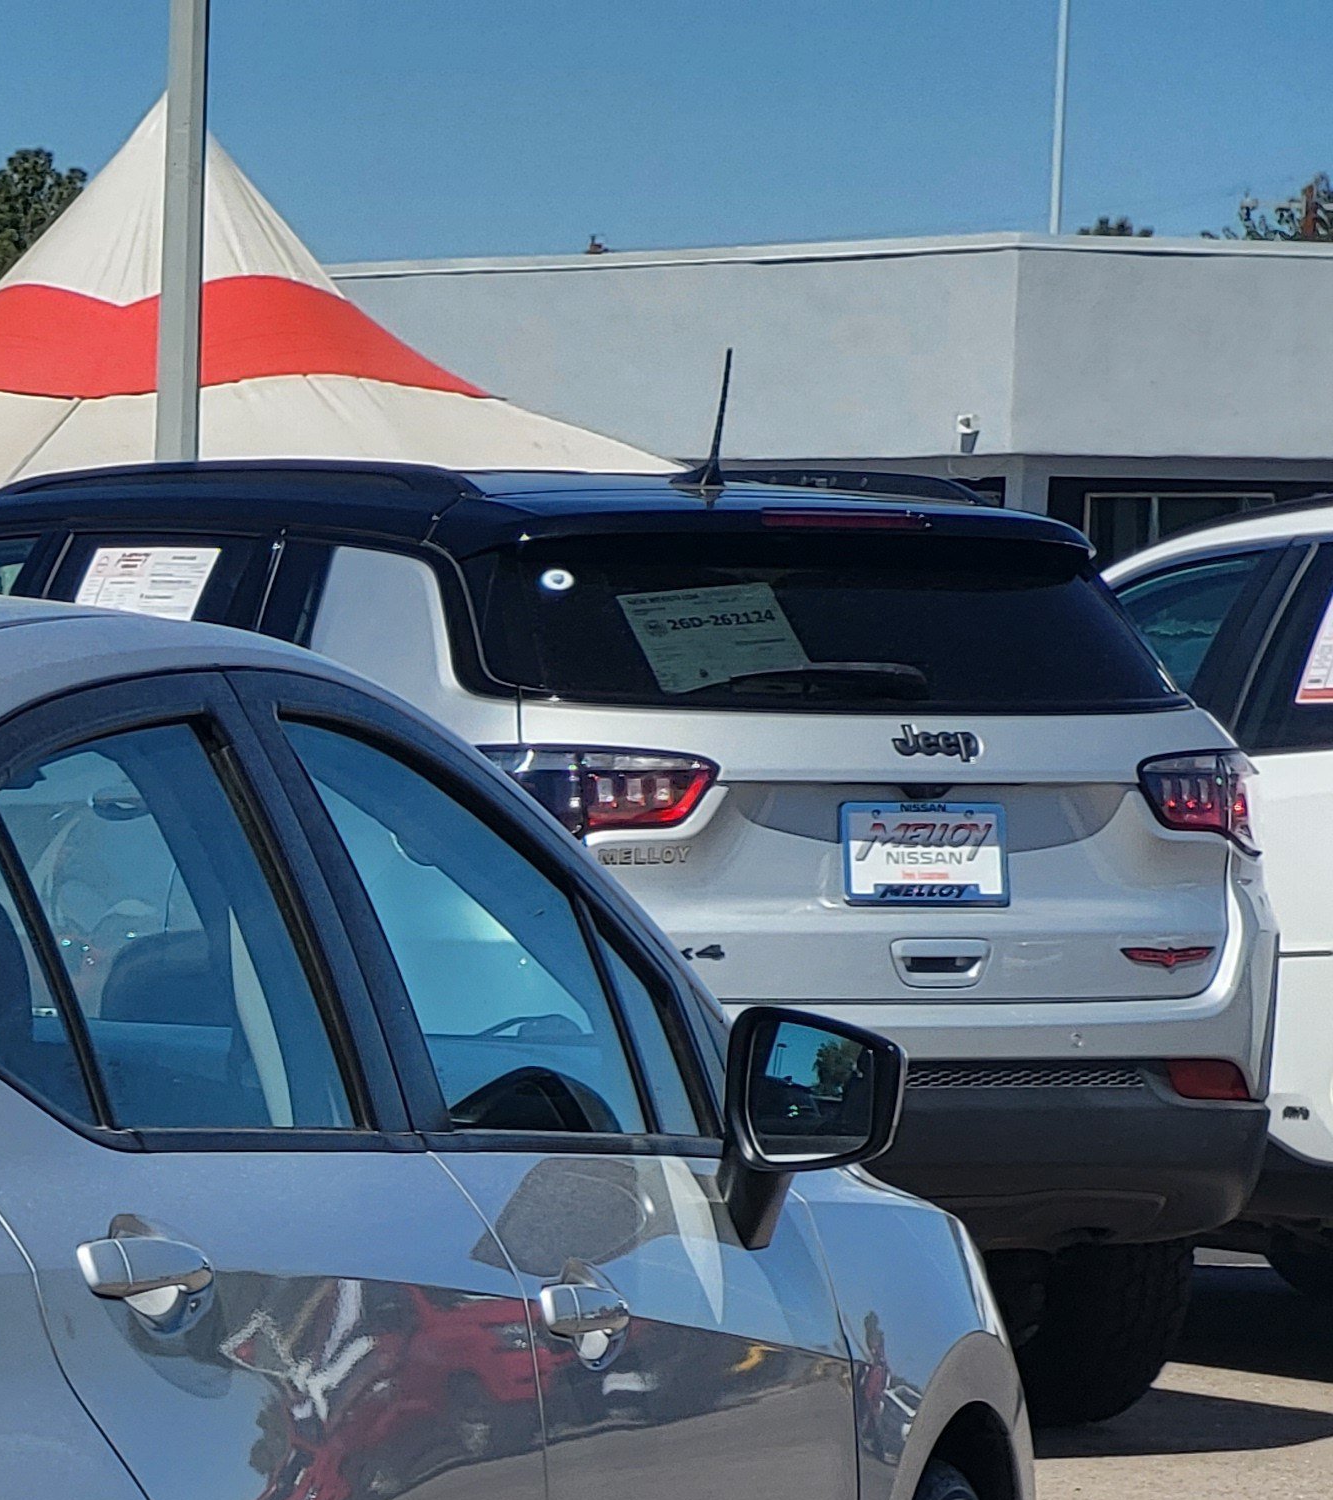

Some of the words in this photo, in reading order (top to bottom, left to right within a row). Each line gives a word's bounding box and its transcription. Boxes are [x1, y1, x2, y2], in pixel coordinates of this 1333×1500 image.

[891, 724, 981, 763] Jeep
[900, 803, 947, 812] NISSAN
[856, 822, 992, 861] MELLOY
[598, 846, 691, 865] MELLOY
[886, 851, 962, 865] NISSAN
[879, 885, 970, 898] MELLOY
